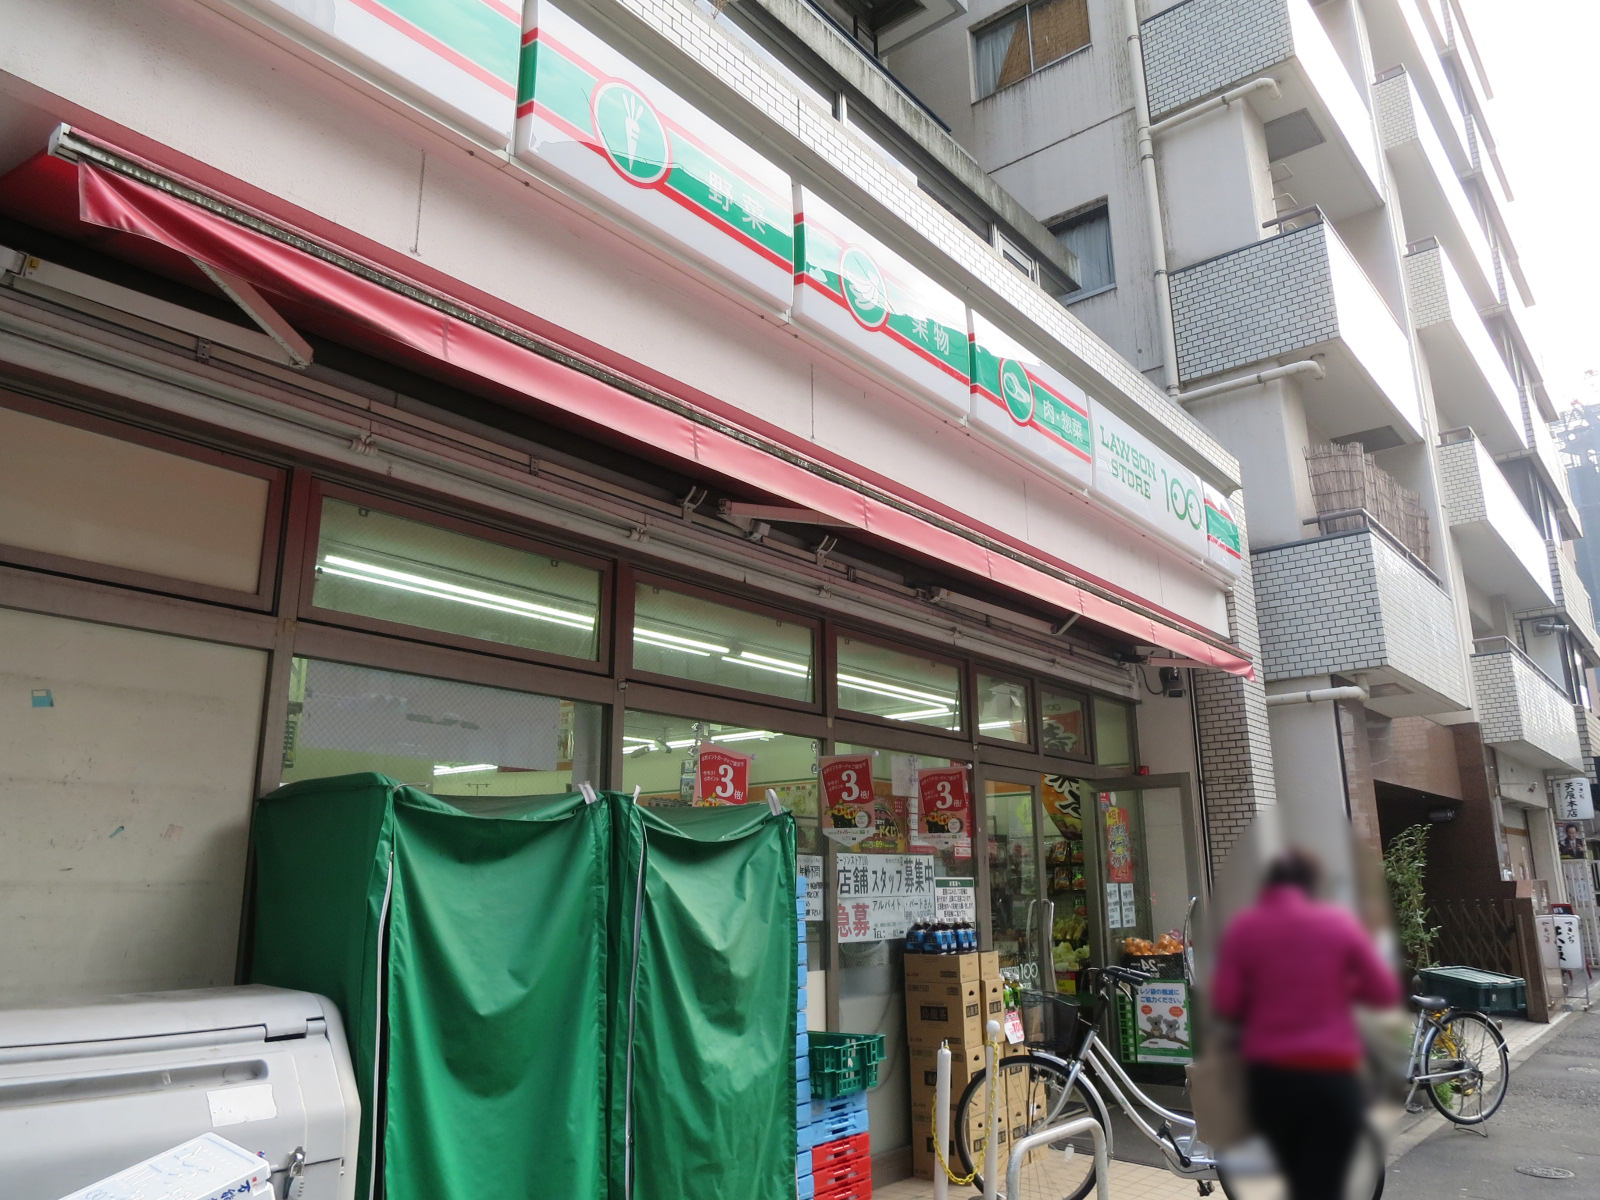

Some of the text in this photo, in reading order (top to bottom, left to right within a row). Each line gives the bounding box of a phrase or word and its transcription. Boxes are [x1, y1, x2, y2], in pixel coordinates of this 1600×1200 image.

[708, 170, 766, 235] 野菜
[911, 311, 950, 355] 果物
[1099, 425, 1157, 481] LAWSON
[1110, 458, 1151, 500] STORE
[1161, 468, 1202, 531] 100
[1564, 781, 1578, 818] 天辰本店
[838, 903, 870, 937] 急募
